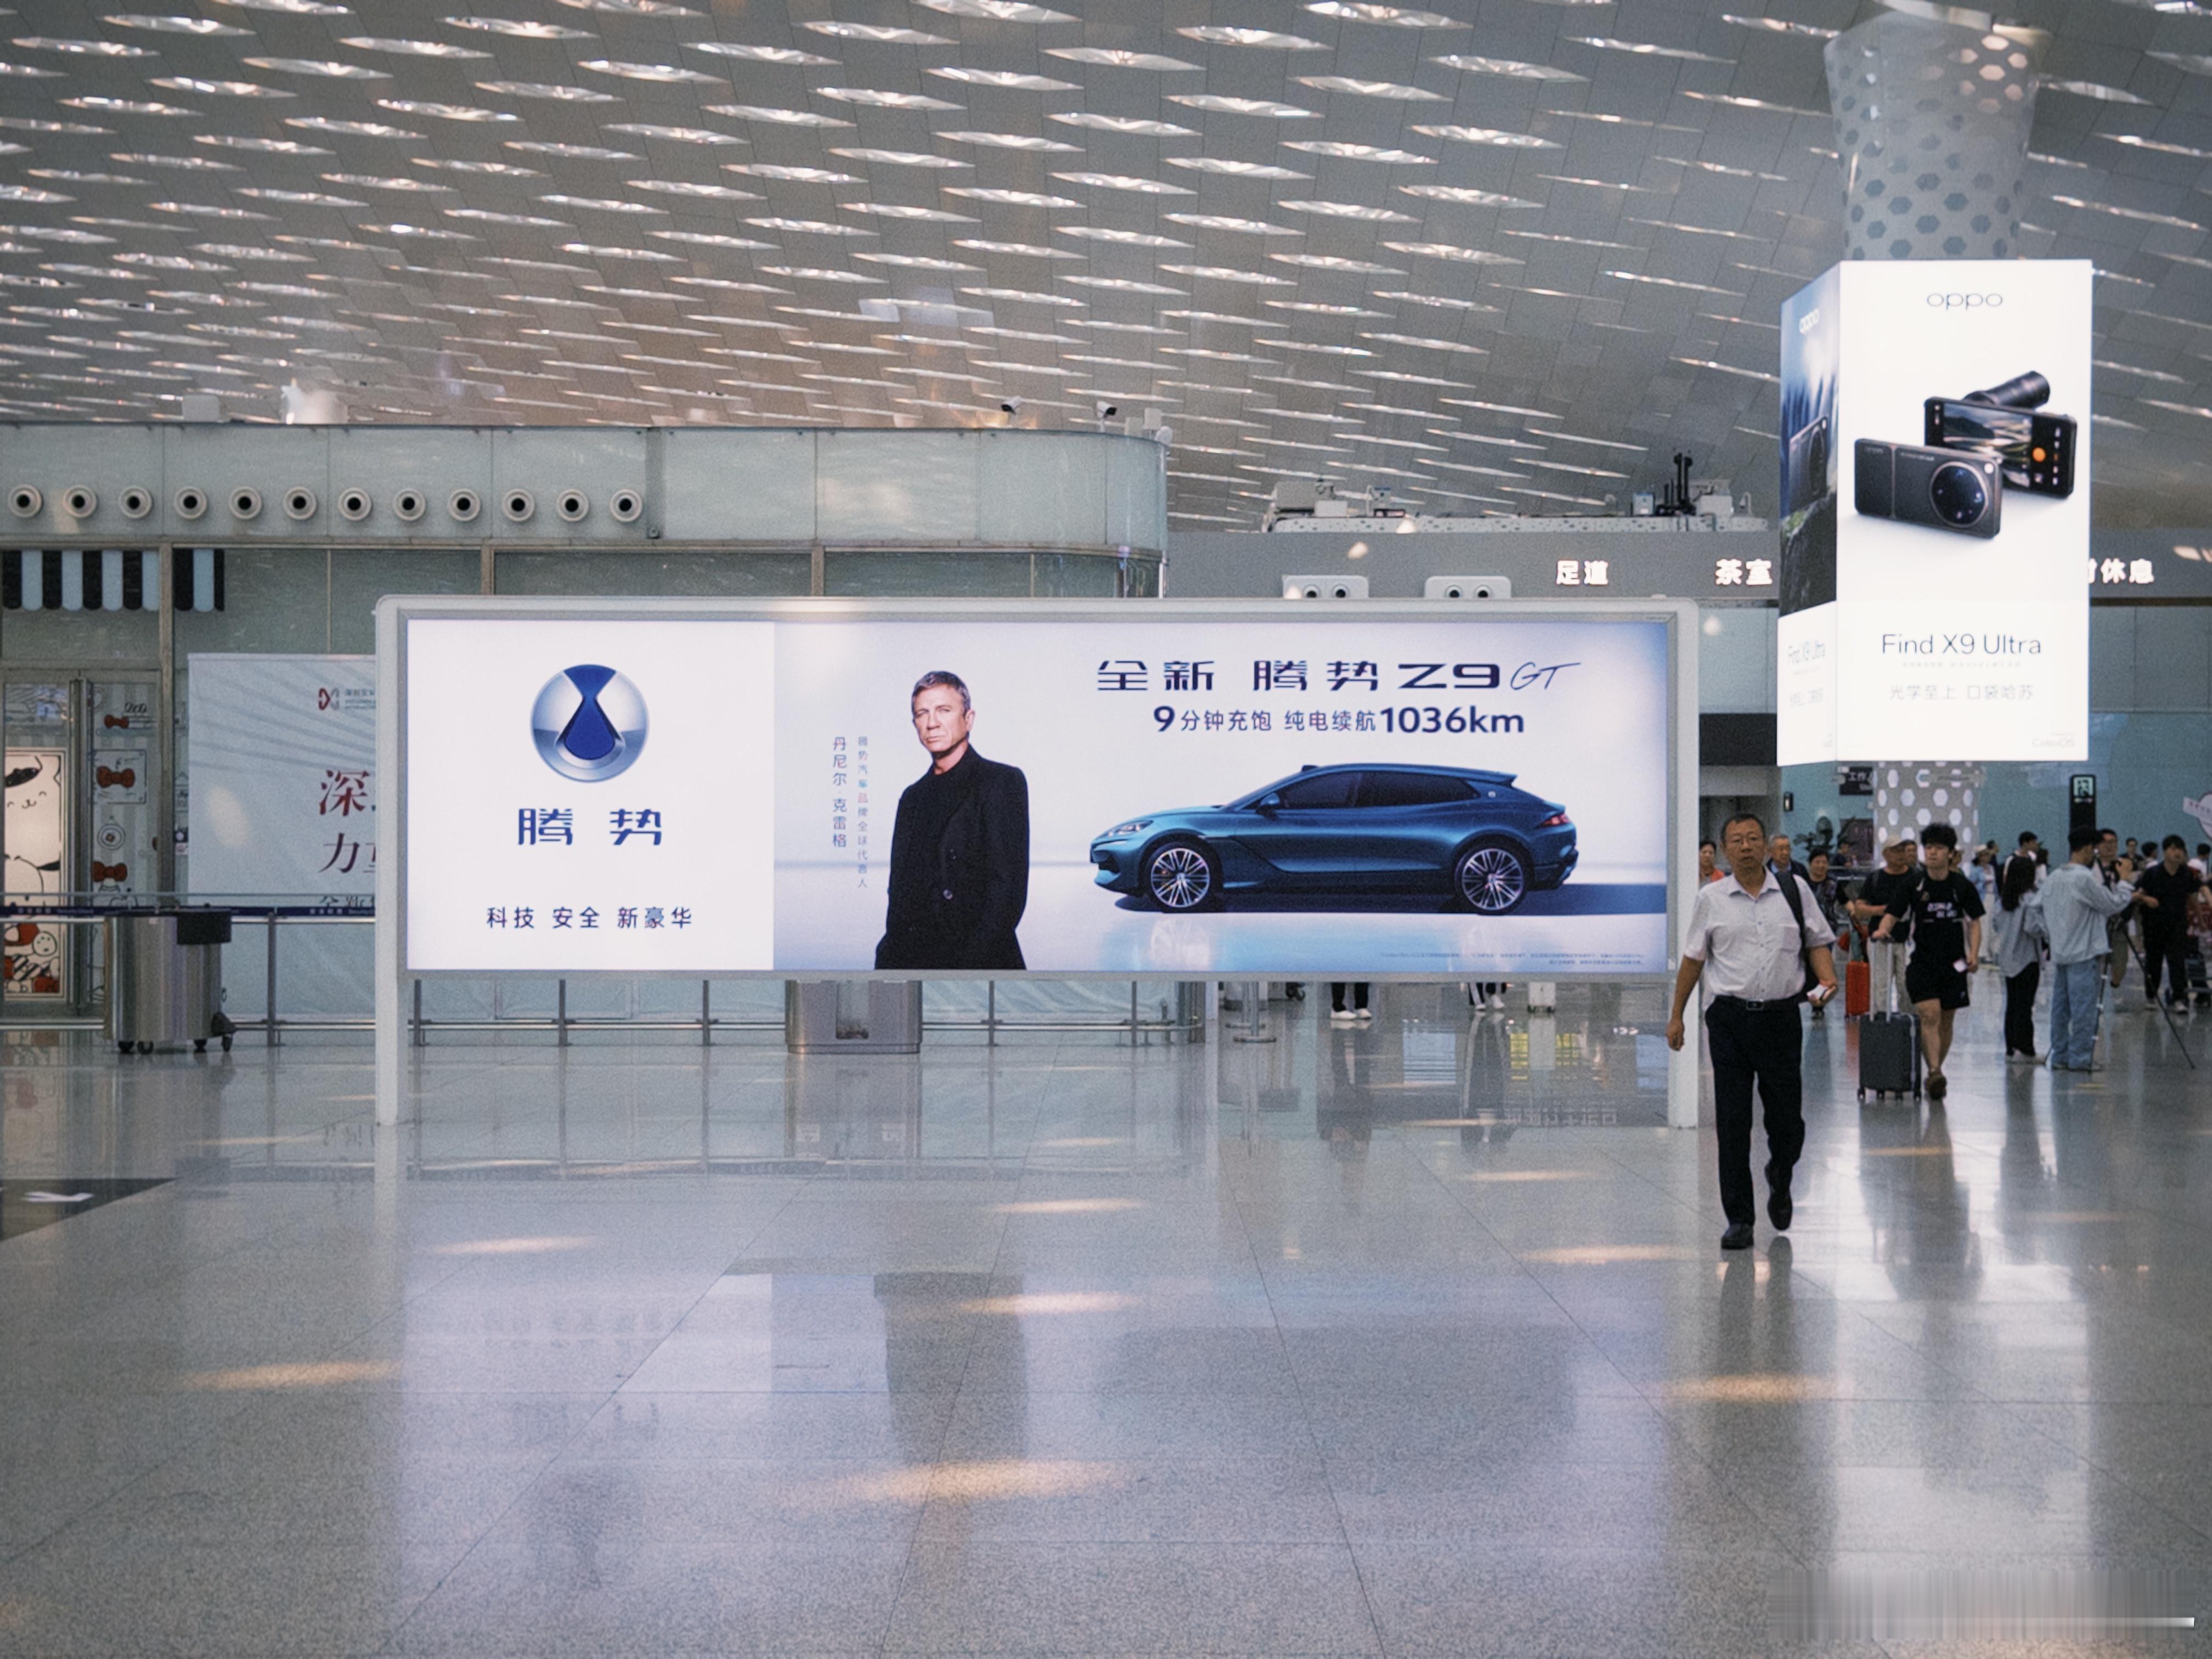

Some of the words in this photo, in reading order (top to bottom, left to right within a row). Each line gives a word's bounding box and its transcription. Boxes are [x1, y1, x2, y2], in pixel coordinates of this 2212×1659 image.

[1556, 560, 1608, 585] 足道
[1716, 558, 1773, 585] 茶室
[1882, 633, 1933, 654] Find
[1942, 633, 1975, 654] X9
[1983, 633, 2041, 654] Ultra
[1097, 660, 1215, 691] 全新
[1889, 685, 1956, 700] 光学至上
[1967, 685, 2034, 700] 口袋哈苏
[1153, 706, 1272, 733] 9分钟充饱
[1284, 706, 1524, 733] 纯电续航1036km
[518, 808, 662, 845] 腾势
[487, 906, 534, 929] 科技
[552, 906, 600, 929] 安全
[618, 906, 692, 929] 新豪华
